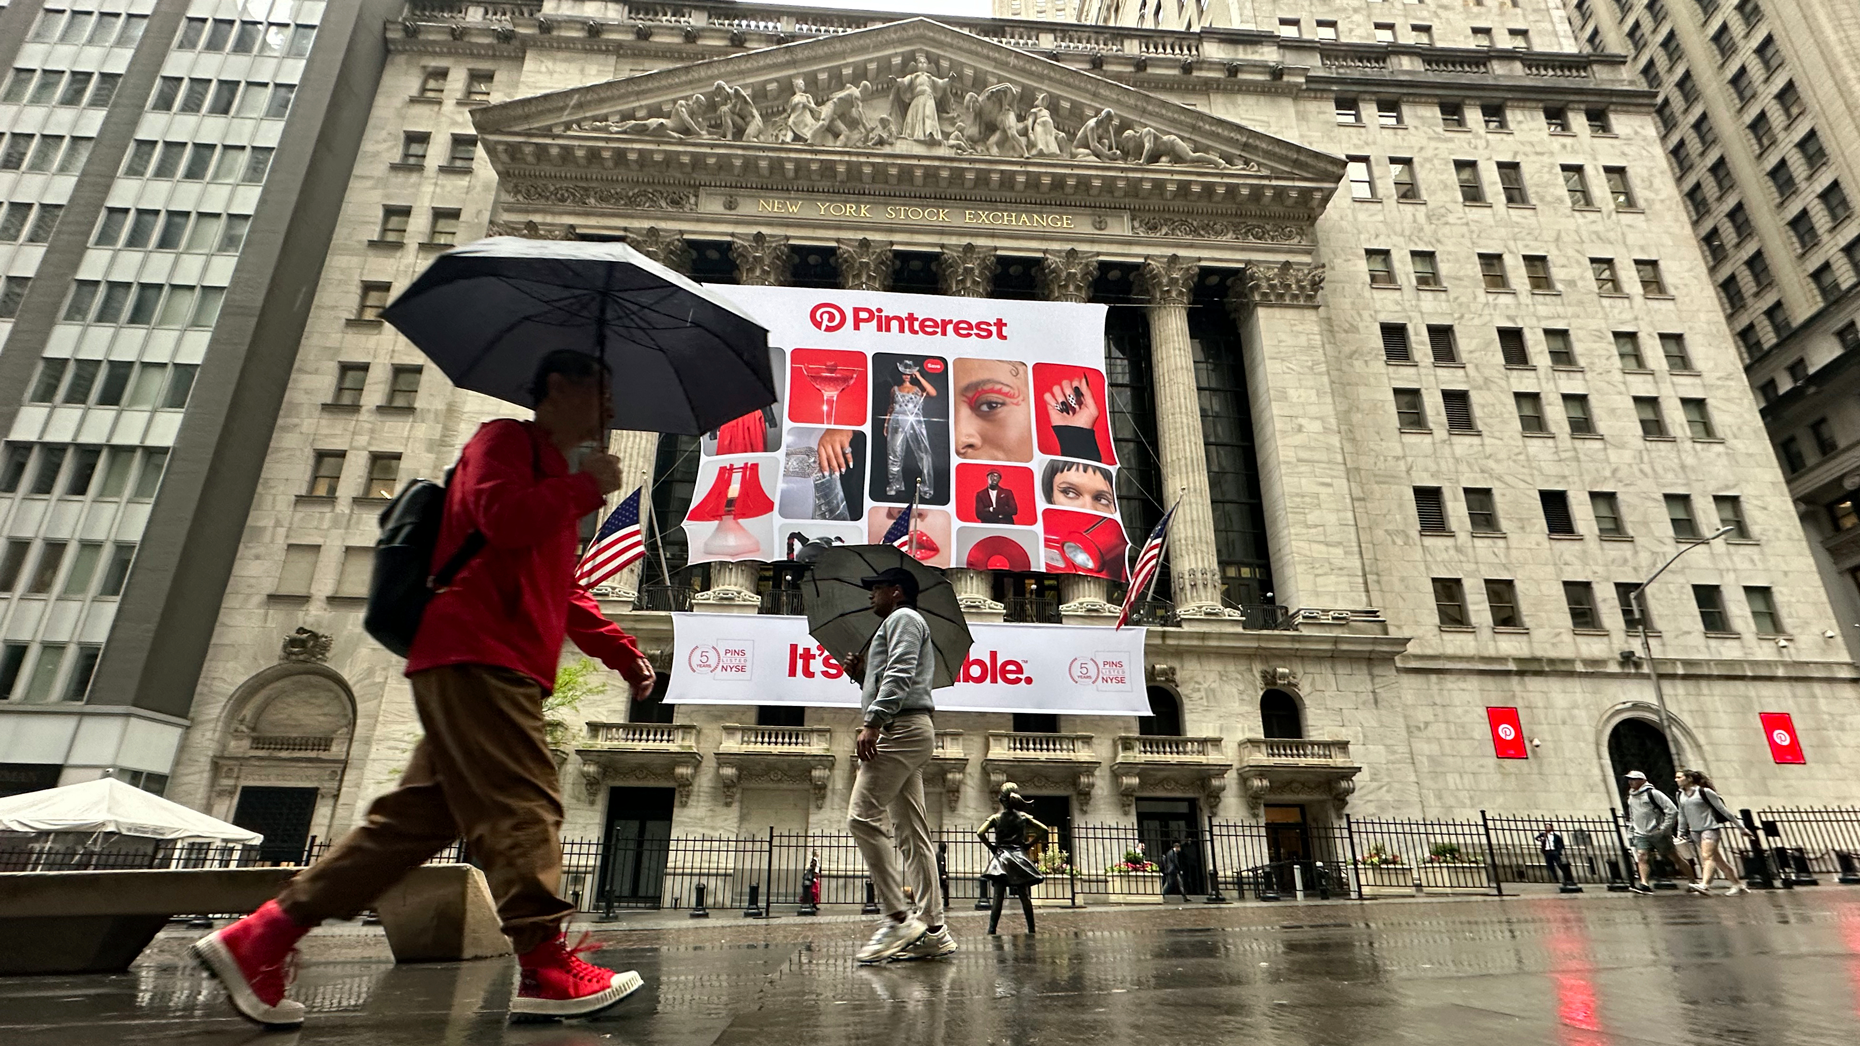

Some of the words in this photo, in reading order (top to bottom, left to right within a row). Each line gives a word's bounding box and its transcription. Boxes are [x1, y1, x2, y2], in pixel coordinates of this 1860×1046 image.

[758, 198, 802, 214] NEW
[817, 202, 873, 218] YORK
[885, 206, 952, 222] STOCK
[964, 210, 1075, 228] EXCHANGE
[852, 306, 1008, 341] Pinterest
[699, 650, 710, 664] 5
[724, 648, 746, 657] PINS
[720, 665, 747, 673] NYSE
[1079, 662, 1089, 676] 5
[1102, 660, 1123, 668] PINS
[1101, 676, 1127, 684] NYSE
